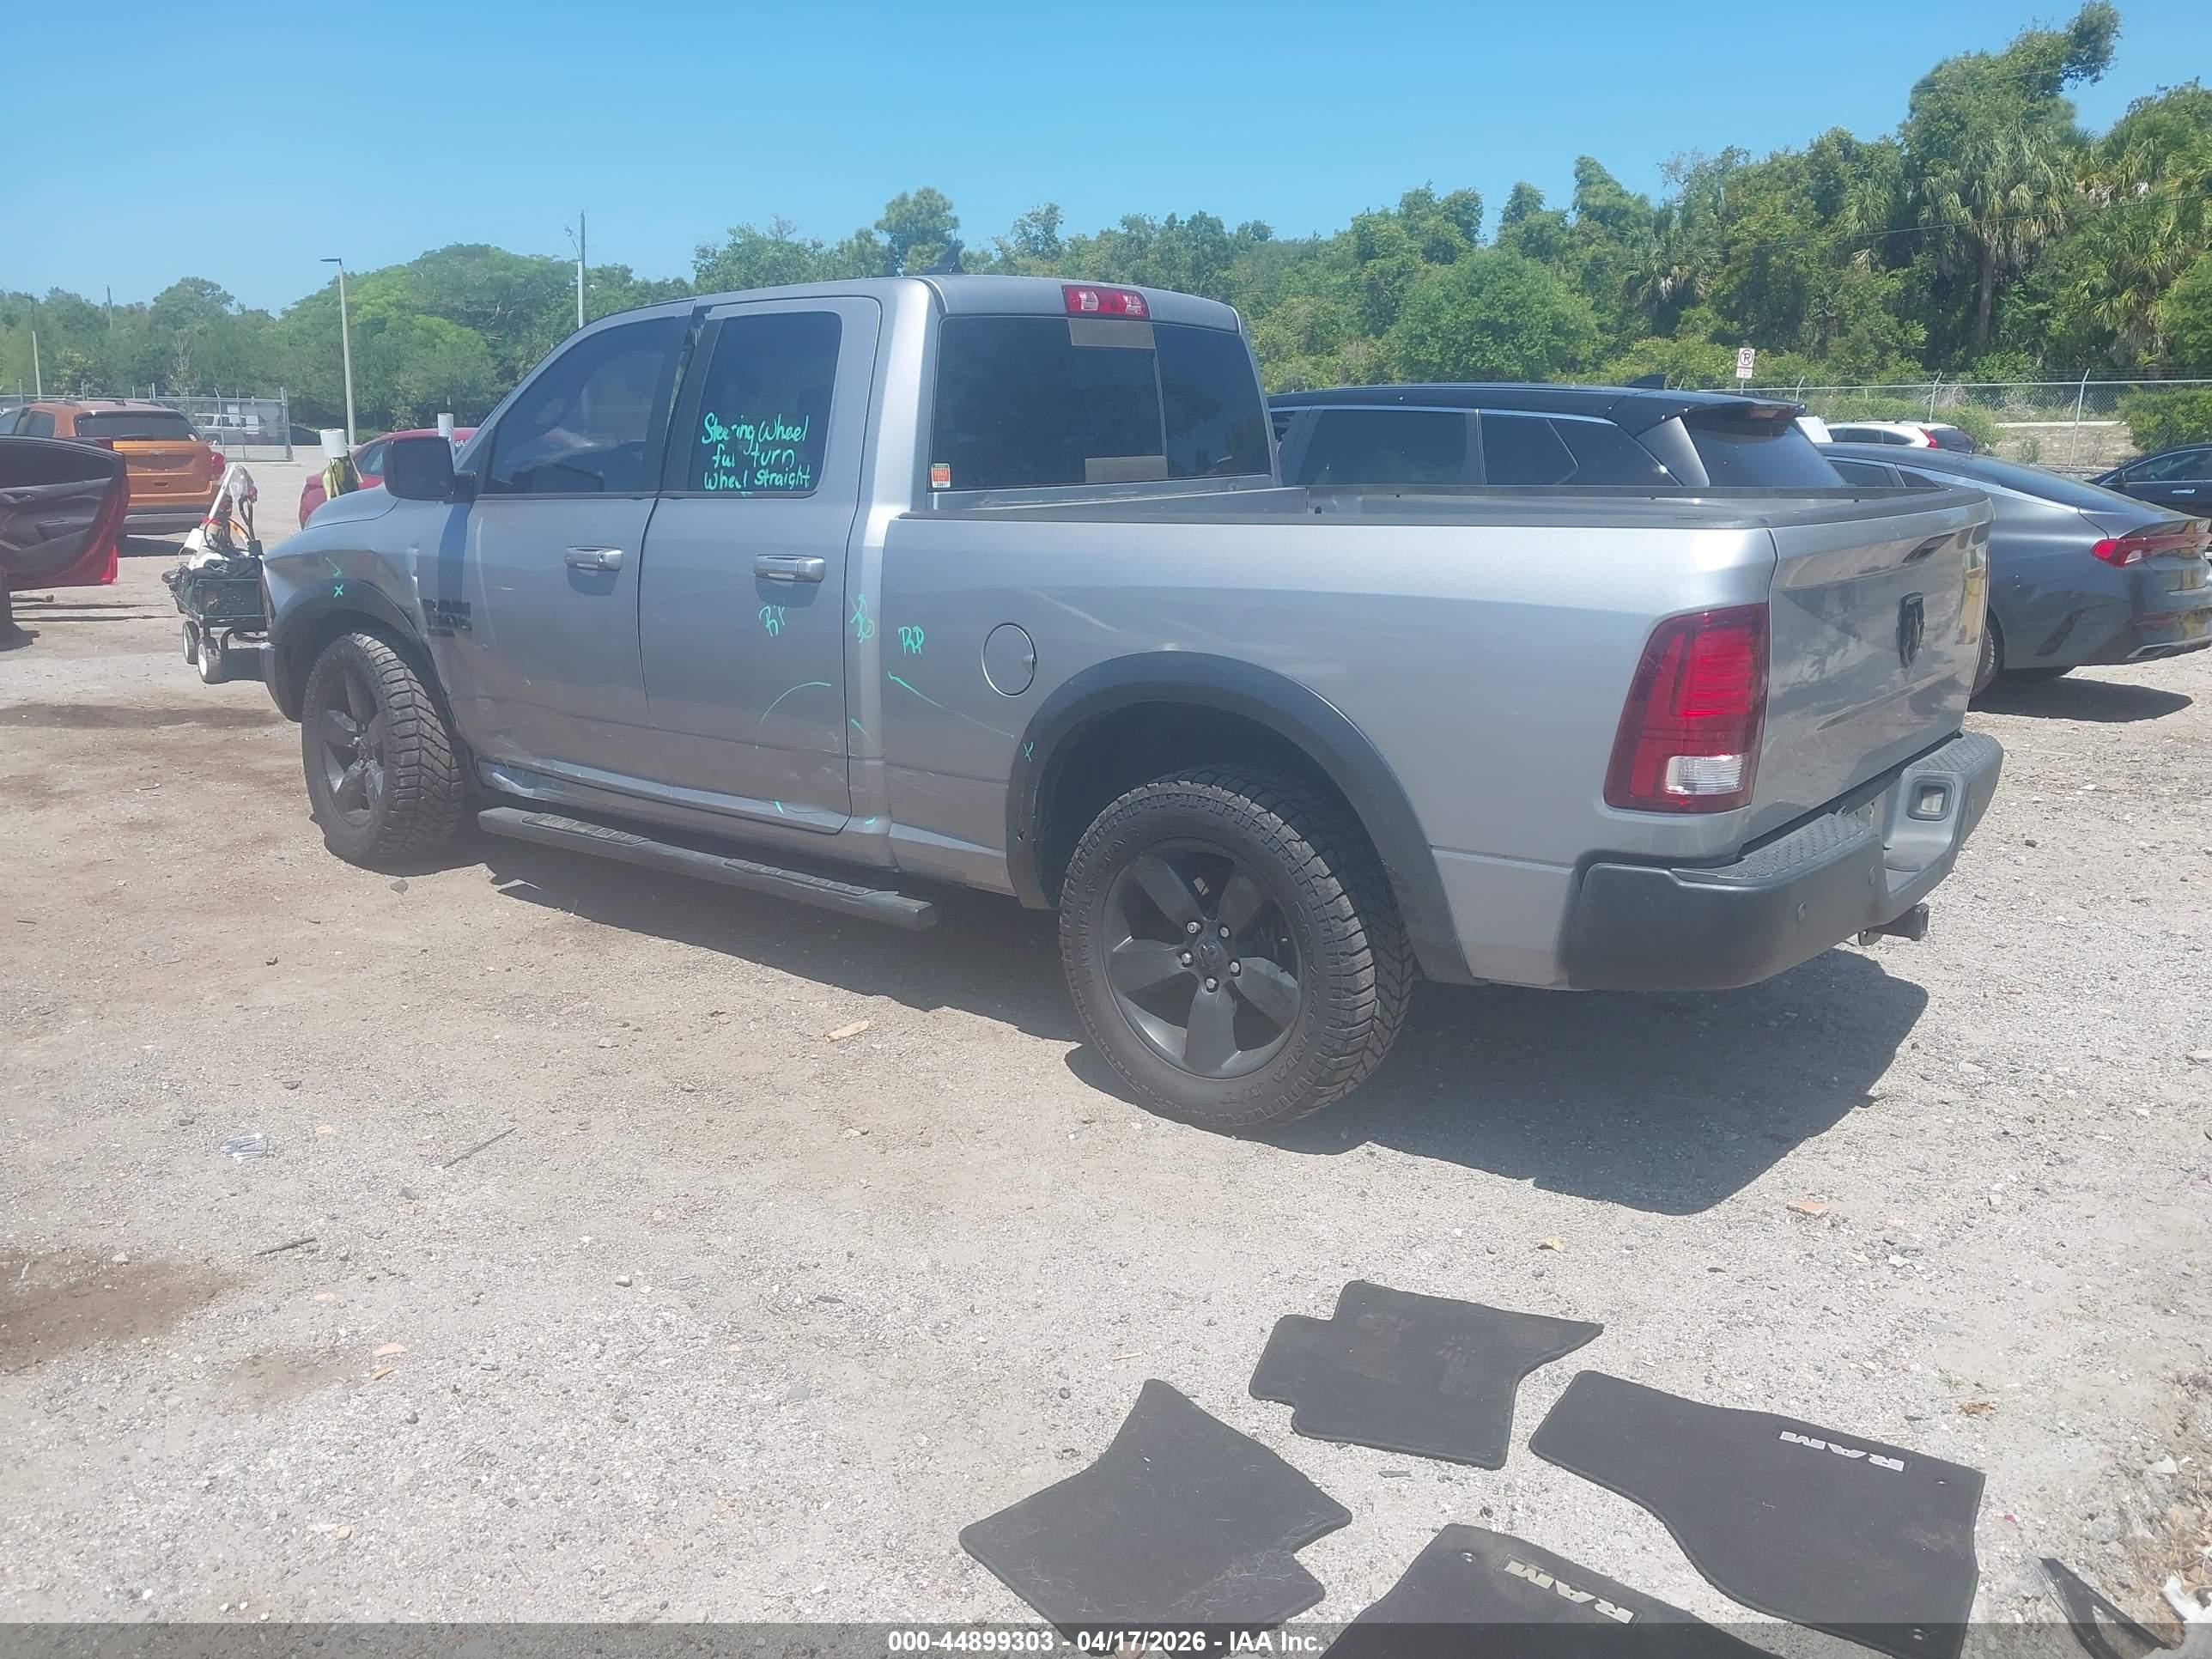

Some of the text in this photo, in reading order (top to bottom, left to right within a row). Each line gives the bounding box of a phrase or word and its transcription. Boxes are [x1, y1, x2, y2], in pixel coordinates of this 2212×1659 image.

[701, 411, 810, 455] Steering Wheel
[750, 442, 795, 469] turn
[1779, 1431, 1905, 1473] RAM
[1504, 1559, 1635, 1625] RAM
